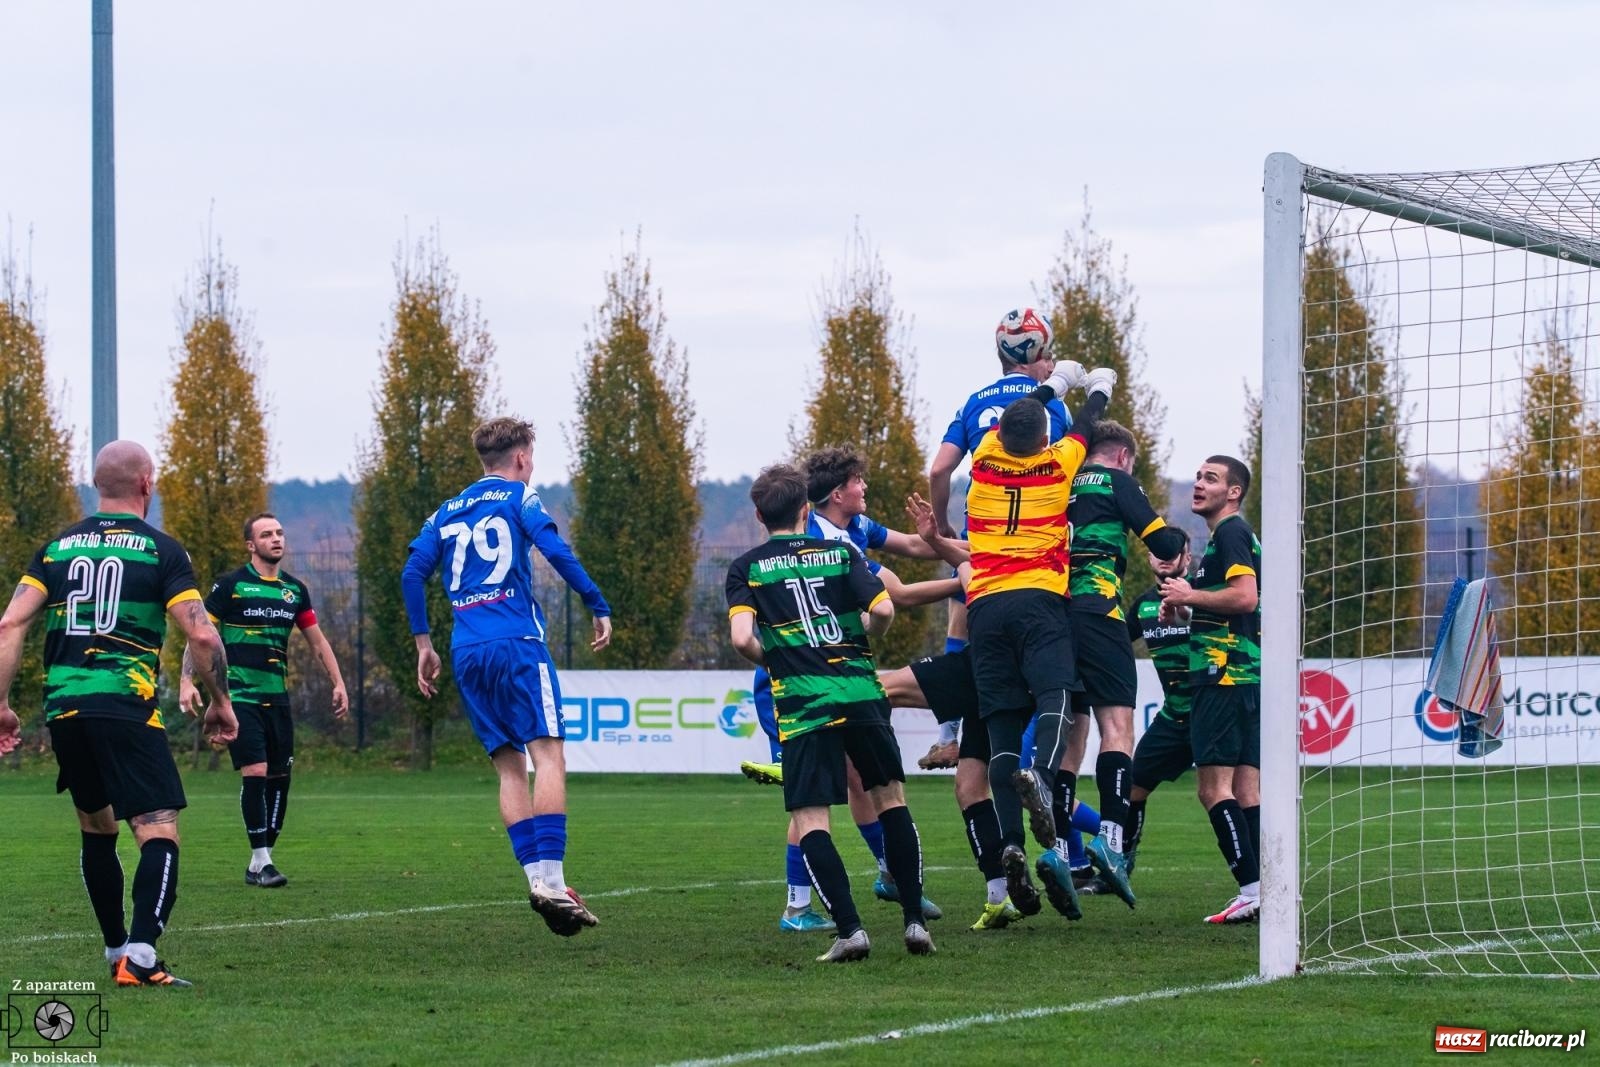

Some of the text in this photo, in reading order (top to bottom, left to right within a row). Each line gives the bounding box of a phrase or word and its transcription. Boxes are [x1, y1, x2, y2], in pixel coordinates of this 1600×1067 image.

[977, 387, 1000, 400] UNIA
[447, 499, 464, 511] NIA
[1004, 486, 1022, 536] 1
[58, 532, 146, 552] NAPRZÓD SYRYNIA
[440, 514, 513, 592] 79
[801, 549, 842, 568] SYRYNIA
[65, 555, 124, 636] 20
[784, 576, 843, 648] 15
[1503, 687, 1600, 717] Marc
